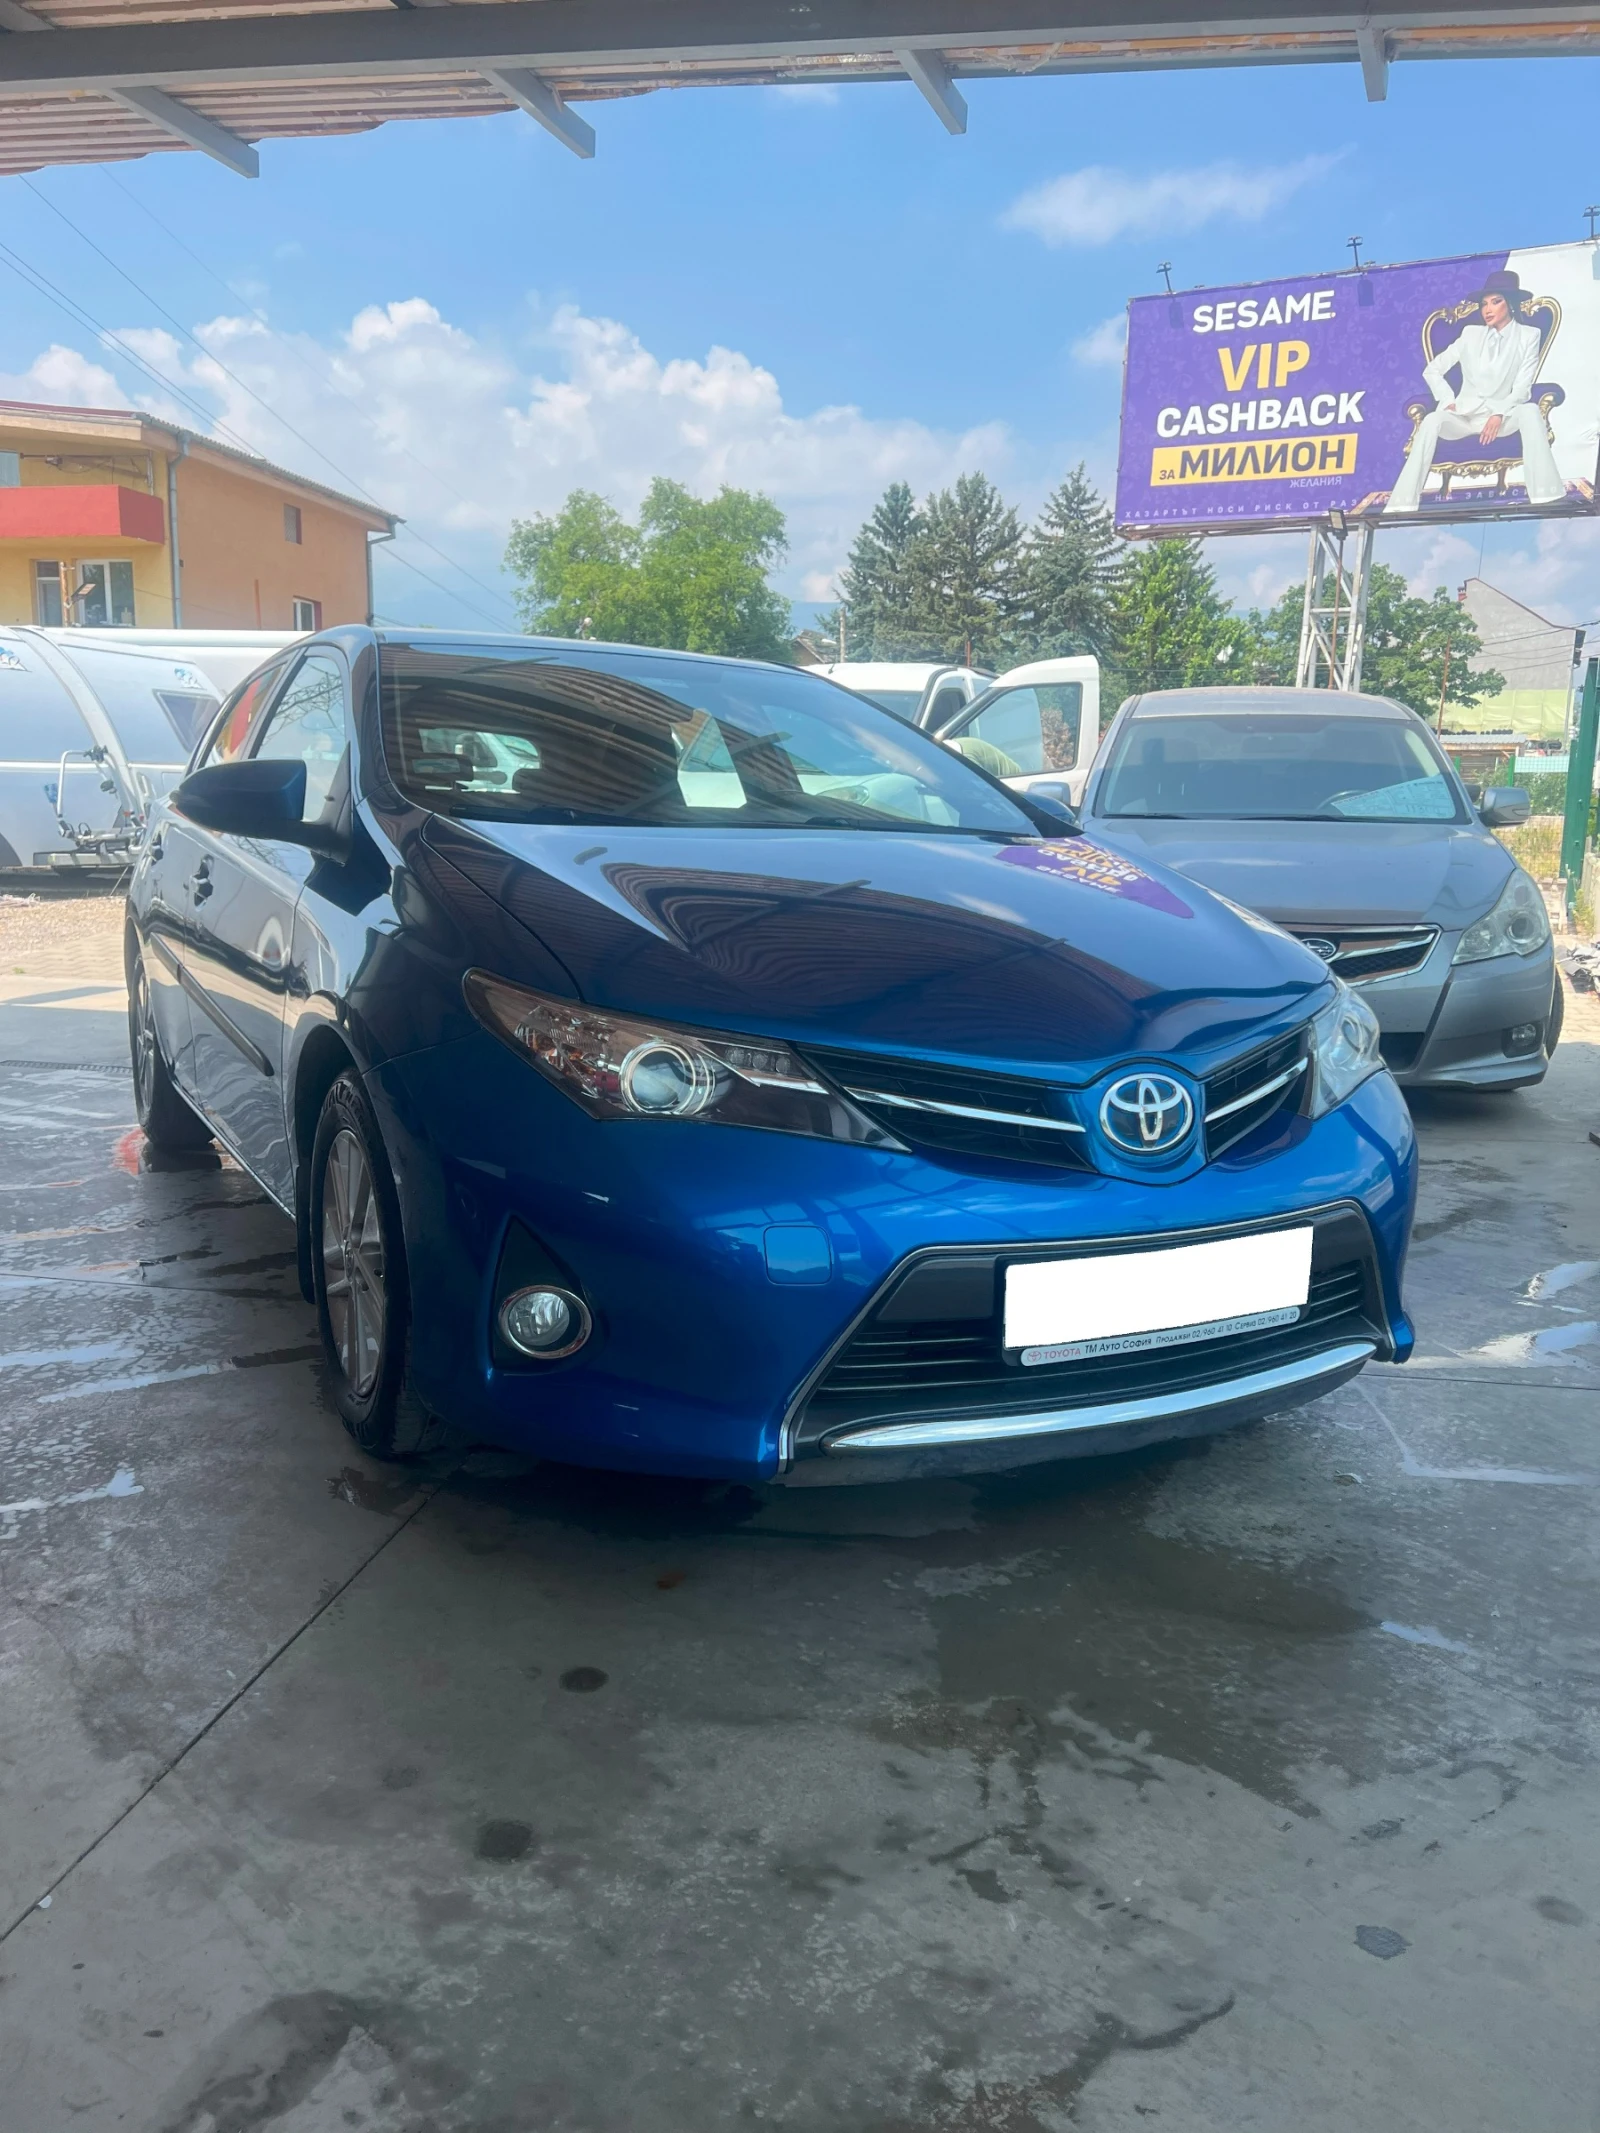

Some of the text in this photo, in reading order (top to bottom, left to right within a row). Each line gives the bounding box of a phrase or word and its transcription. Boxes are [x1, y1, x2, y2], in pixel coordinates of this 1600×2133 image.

[1217, 340, 1311, 392] VIP
[1156, 391, 1366, 438] CASHBACK
[1159, 439, 1346, 481] ЗА МИЛИОН
[1289, 476, 1342, 489] ЖЕЛАНИЯ
[1125, 507, 1197, 519] ХАЗАРТЪТ
[1207, 505, 1245, 514] НОСИ
[1254, 502, 1292, 512] РИСК
[1302, 501, 1320, 510] ОТ
[1044, 1348, 1081, 1359] TOYOTA
[1192, 1327, 1216, 1338] 02/960
[1289, 1311, 1297, 1319] 20
